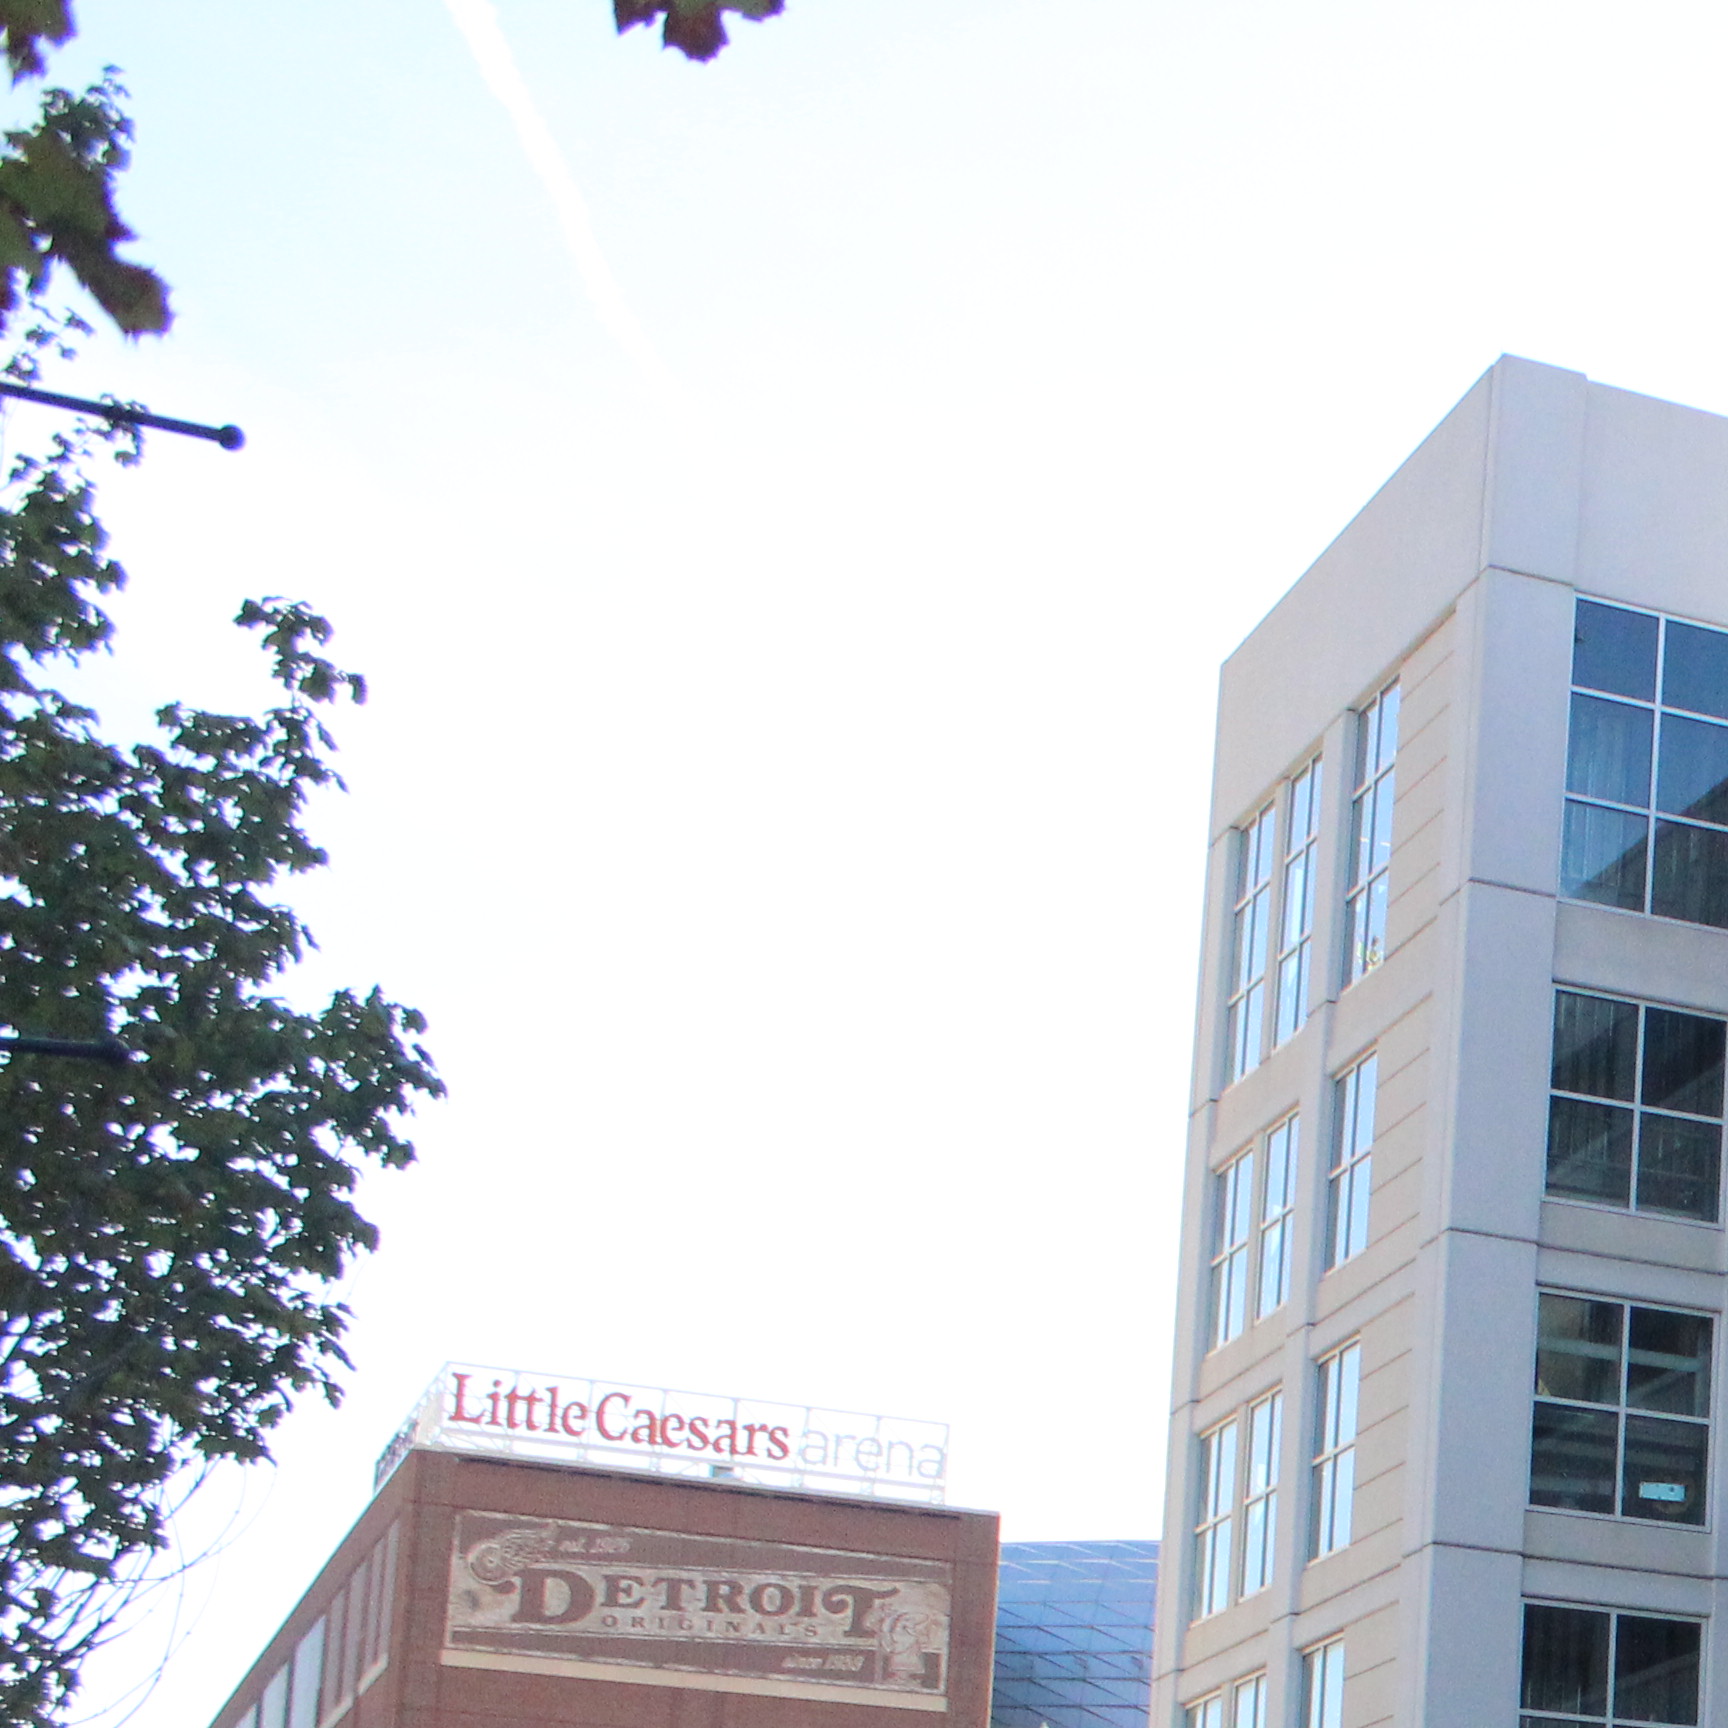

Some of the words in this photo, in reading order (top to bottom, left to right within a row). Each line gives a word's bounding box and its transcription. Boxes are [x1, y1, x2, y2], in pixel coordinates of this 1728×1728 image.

[448, 1371, 588, 1437] Little
[596, 1391, 790, 1461] Caesars
[798, 1430, 945, 1480] arena
[490, 1565, 901, 1638] DETROIT
[600, 1613, 820, 1638] ORIGINALS
